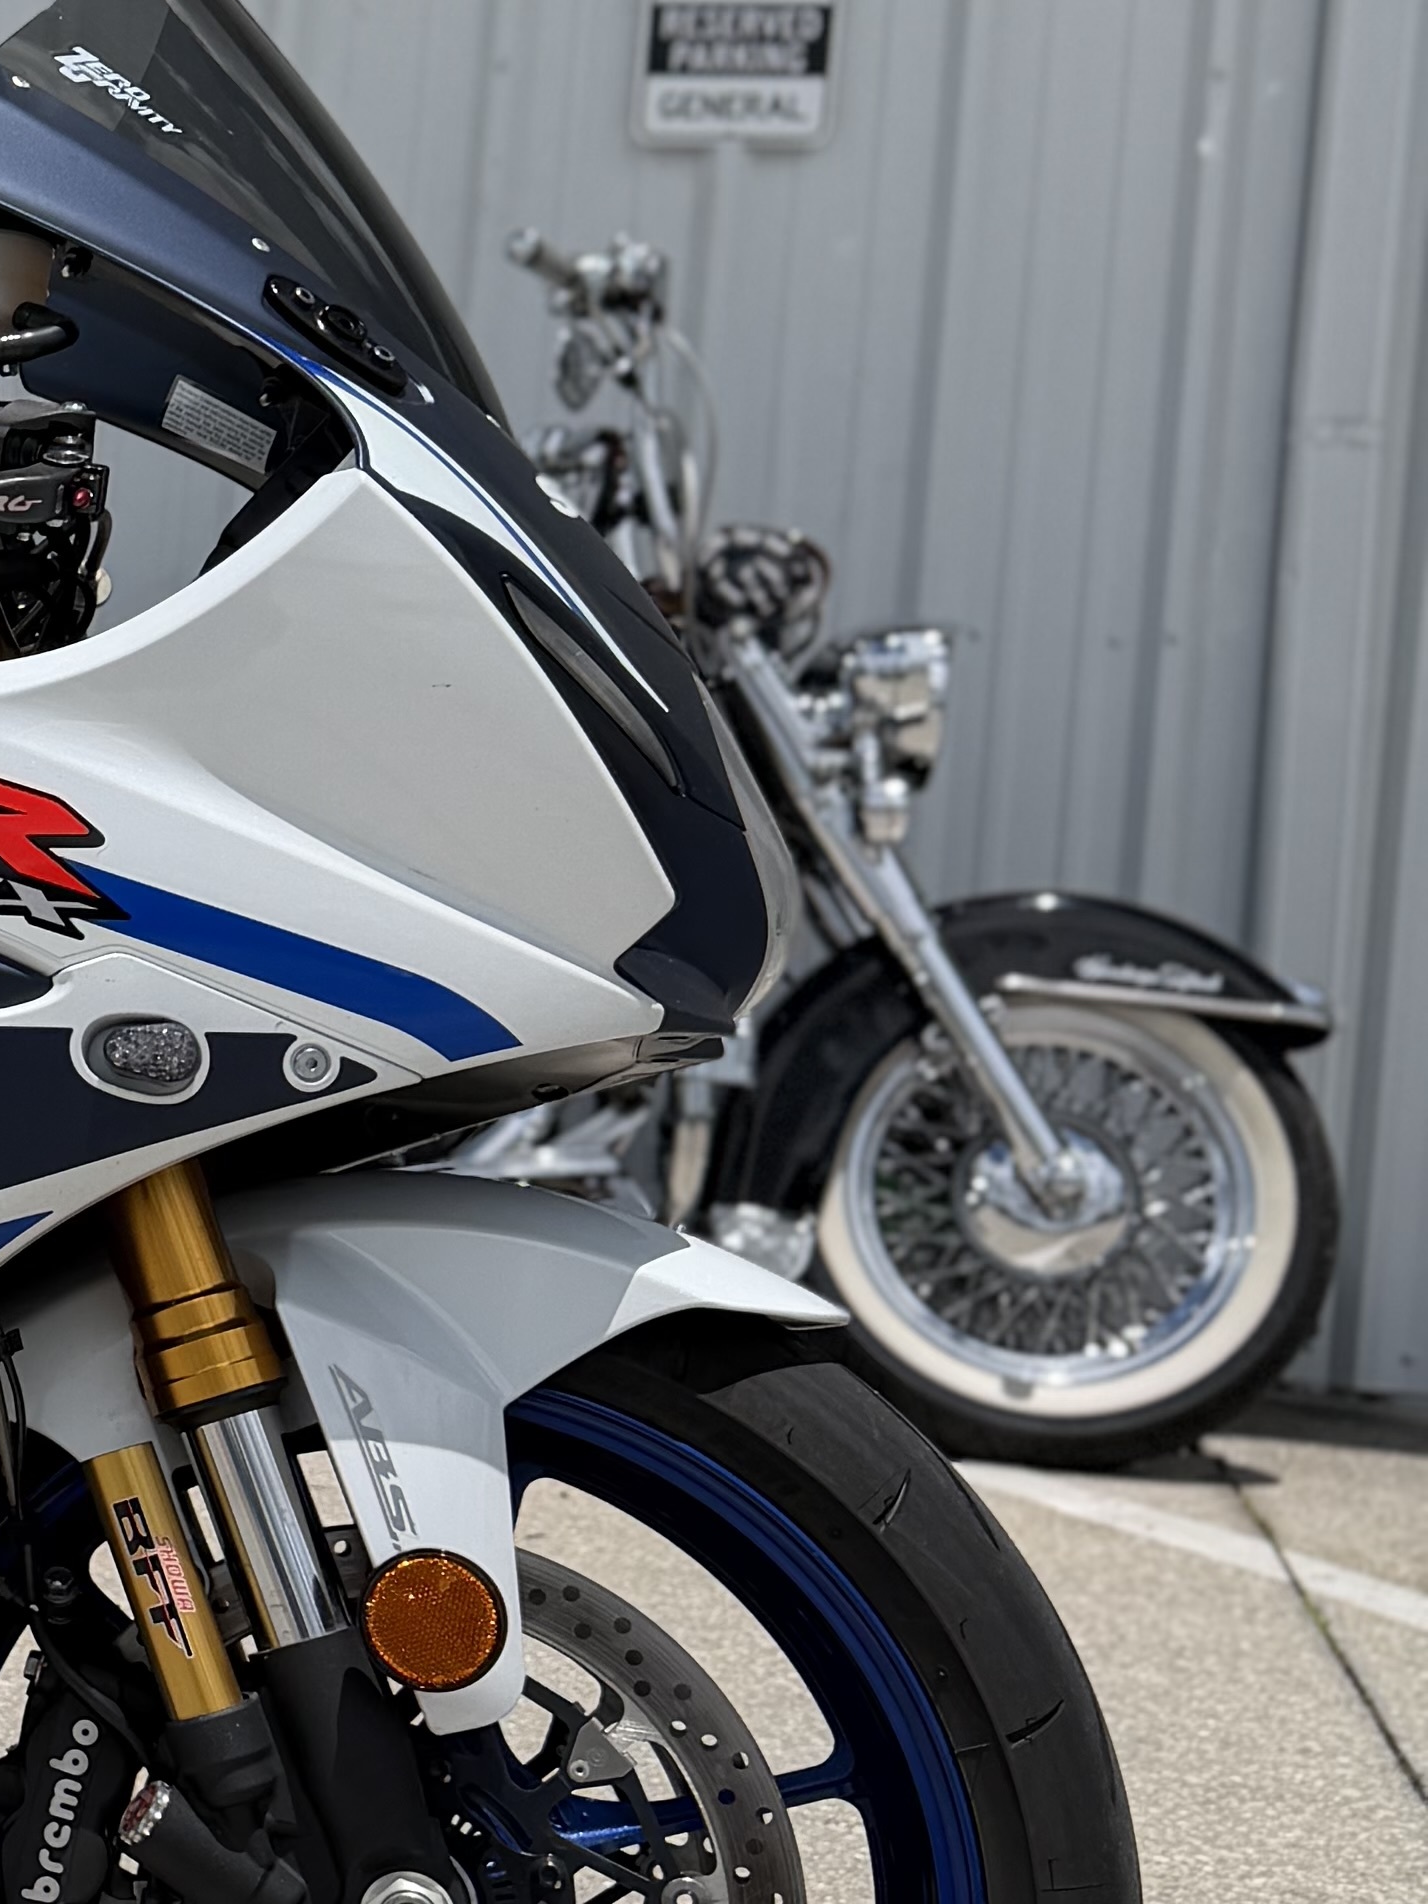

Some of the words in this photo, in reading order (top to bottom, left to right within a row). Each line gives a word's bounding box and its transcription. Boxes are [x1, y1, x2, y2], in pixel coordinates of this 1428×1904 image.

[657, 6, 824, 42] RESERVED
[665, 41, 810, 75] PARKING
[656, 89, 808, 123] GENERAL
[331, 1362, 419, 1539] ABS
[155, 1534, 196, 1613] SHOWA
[20, 1718, 100, 1904] brembo
